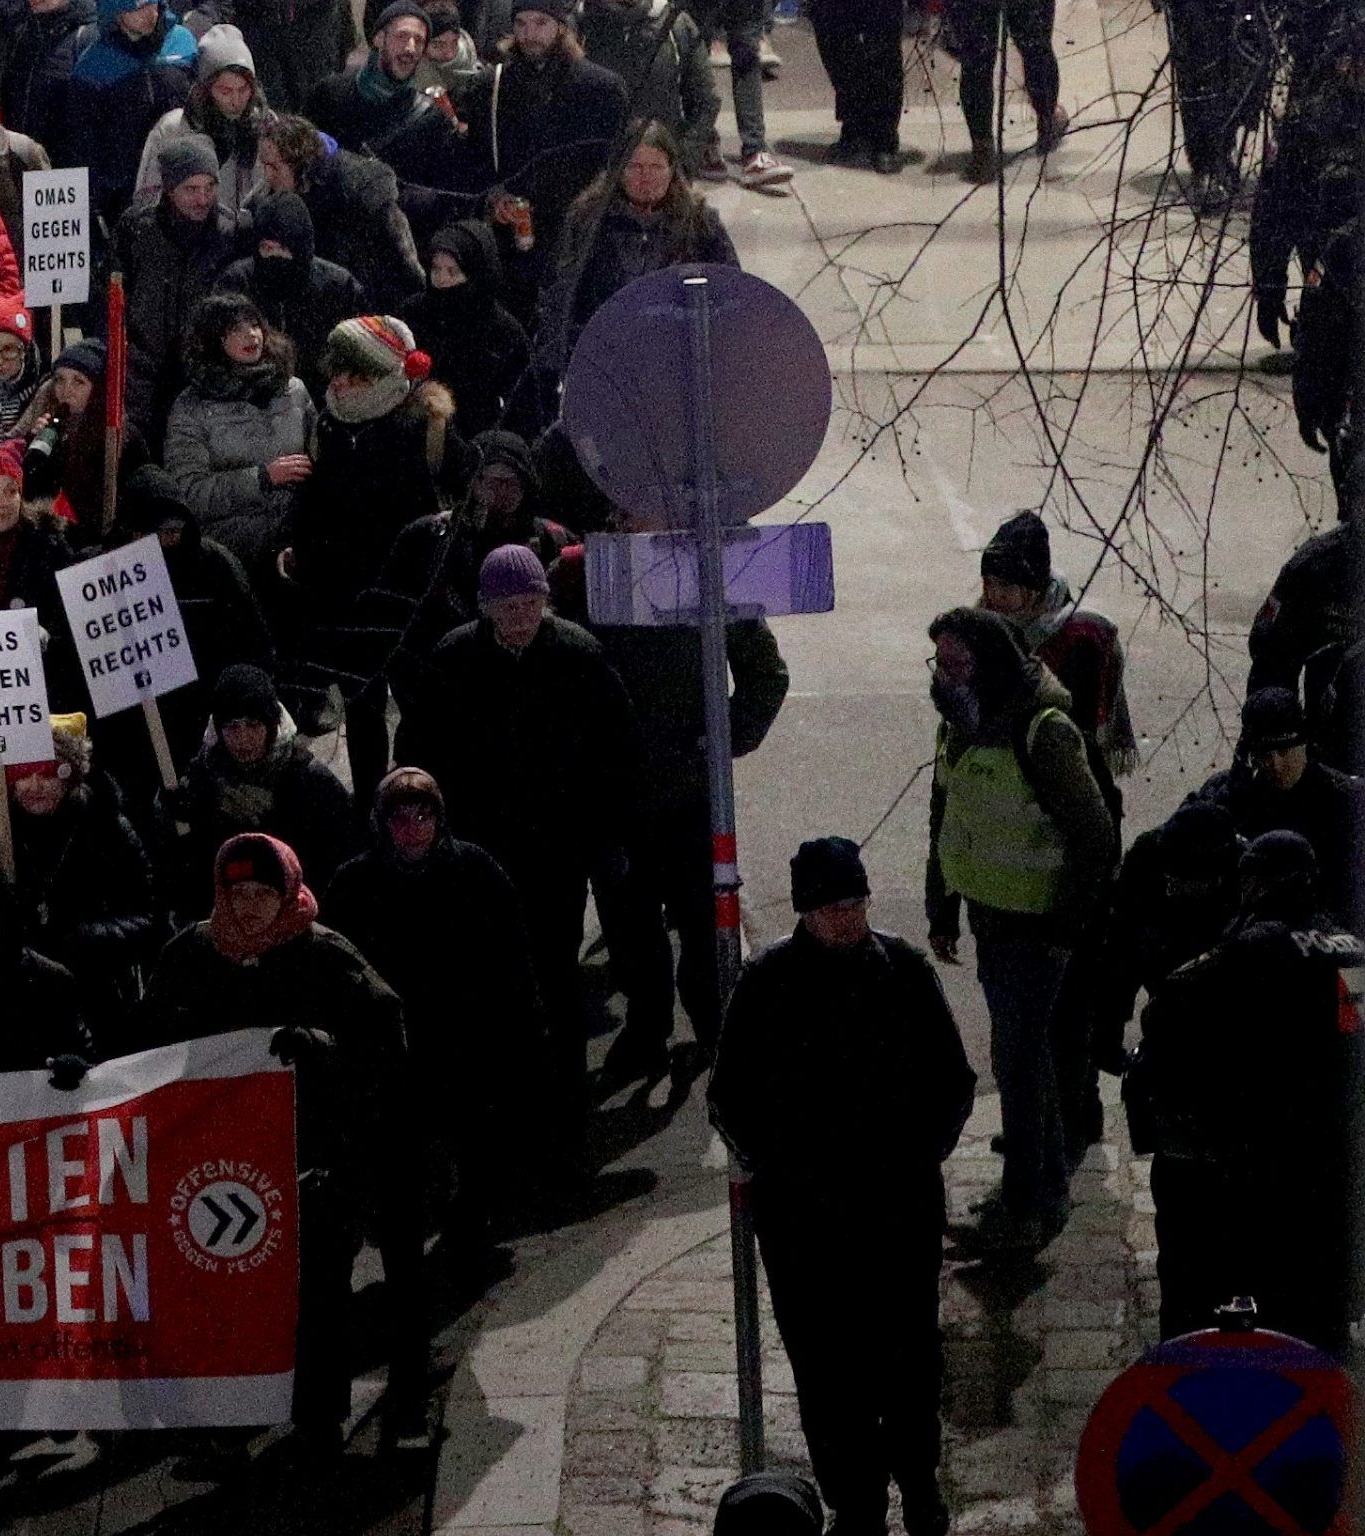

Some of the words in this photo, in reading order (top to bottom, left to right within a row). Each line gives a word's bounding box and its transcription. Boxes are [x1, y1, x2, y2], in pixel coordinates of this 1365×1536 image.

[34, 187, 77, 206] OMAS
[31, 218, 82, 239] GEGEN
[27, 249, 87, 273] RECHTS
[80, 563, 149, 603] OMAS
[84, 594, 165, 640] GEGEN
[87, 627, 182, 679] RECHTS
